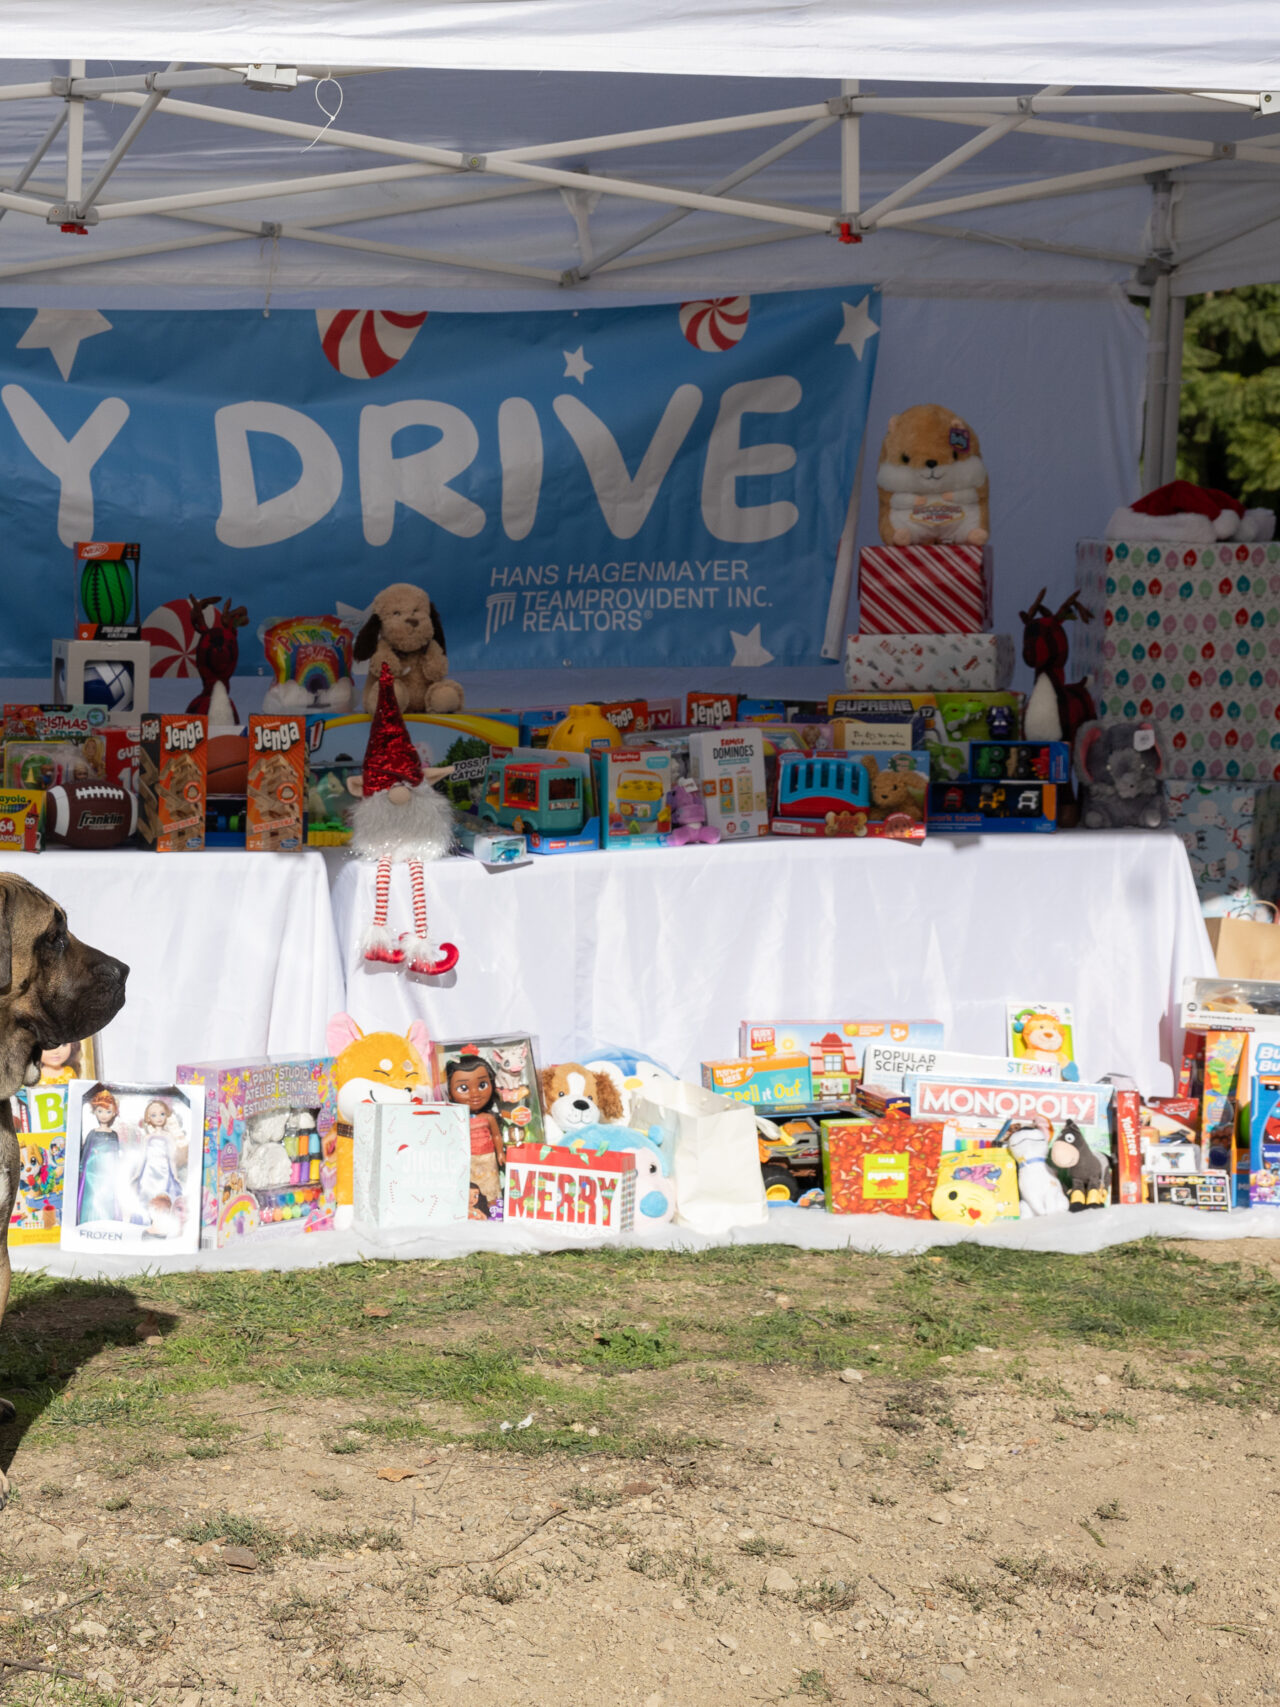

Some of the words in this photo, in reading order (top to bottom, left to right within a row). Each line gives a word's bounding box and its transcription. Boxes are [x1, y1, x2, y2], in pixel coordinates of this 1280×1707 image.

[214, 375, 803, 549] DRIVE
[490, 564, 559, 587] HANS
[566, 560, 749, 584] HAGENMAYER
[522, 587, 719, 611] TEAMPROVIDENT
[727, 585, 774, 608] INC.
[690, 699, 732, 725] Jenga
[835, 700, 912, 713] SUPREME
[165, 720, 205, 751] Jenga
[254, 721, 300, 751] Jenga
[713, 745, 754, 759] DOMINOES
[874, 1049, 937, 1065] POPULAR
[875, 1060, 934, 1073] SCIENCE
[253, 1067, 278, 1084] PAINT
[278, 1066, 310, 1081] STUDIO
[1007, 1061, 1053, 1076] STEAM
[245, 1083, 277, 1101] ATELIER
[278, 1079, 320, 1095] PEINTURE
[773, 1079, 802, 1100] Out
[243, 1097, 277, 1117] ESTUDIO
[922, 1087, 1092, 1121] MONOPOLY
[1121, 1116, 1138, 1156] Yahtzee
[508, 1168, 619, 1227] MERRY
[79, 1229, 123, 1241] FROZEN
